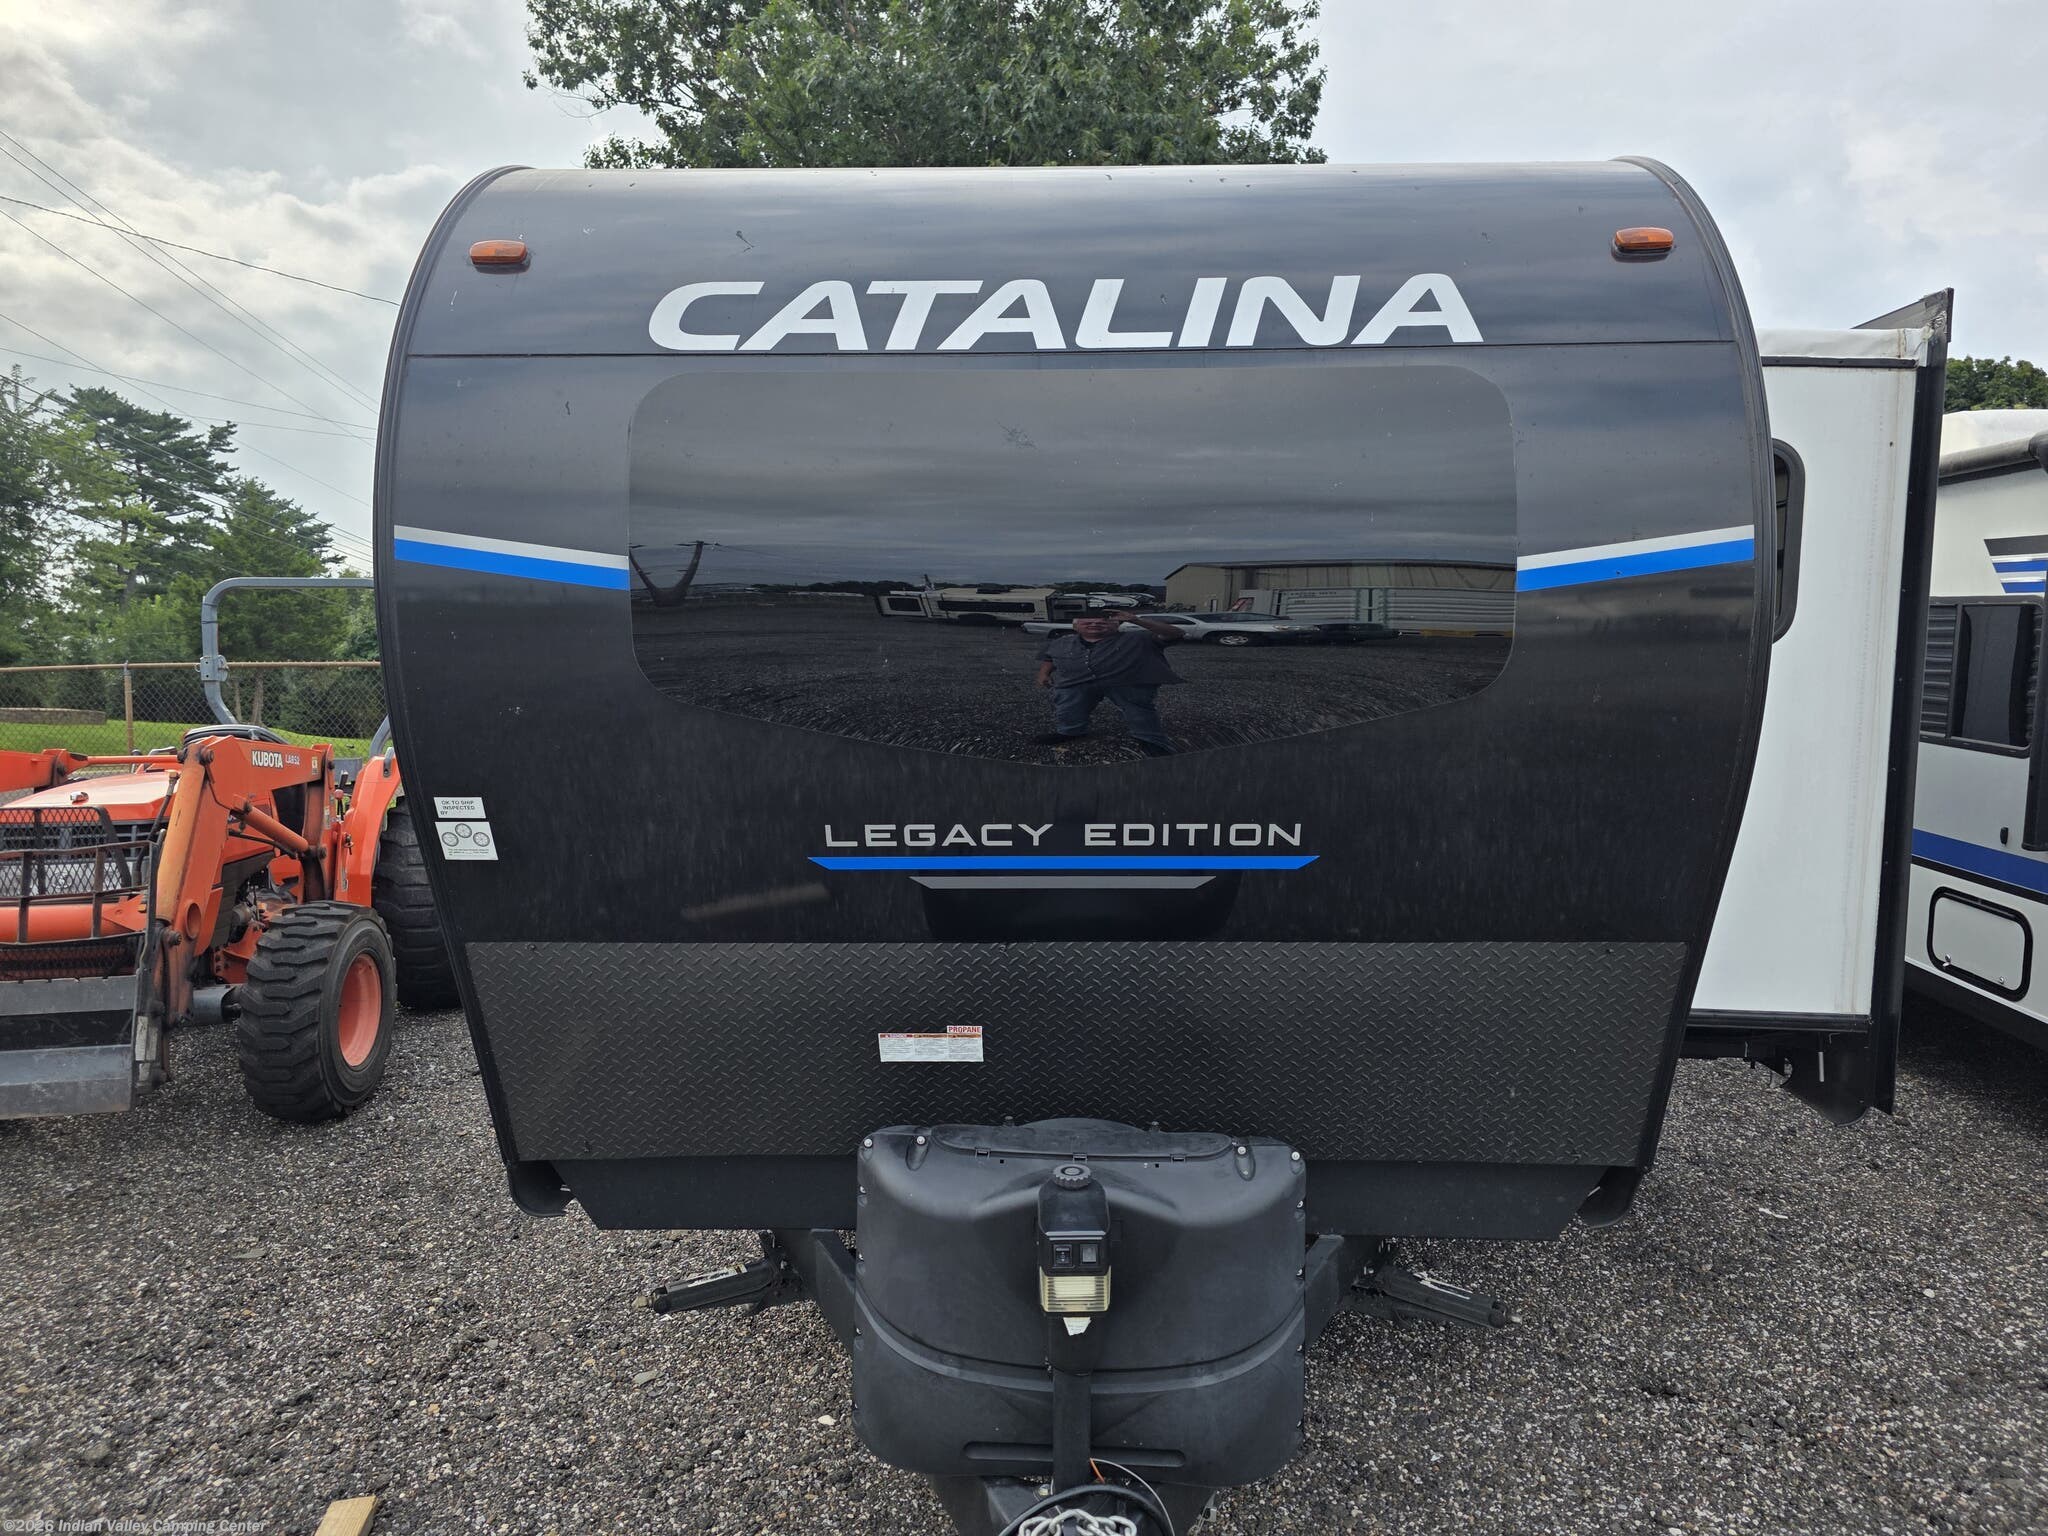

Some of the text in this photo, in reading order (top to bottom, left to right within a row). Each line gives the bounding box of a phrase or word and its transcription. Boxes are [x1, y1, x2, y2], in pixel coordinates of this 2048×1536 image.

[648, 273, 1484, 352] CATALINA
[252, 750, 284, 768] KUBOTA
[825, 823, 1302, 847] LEGACY EDITION
